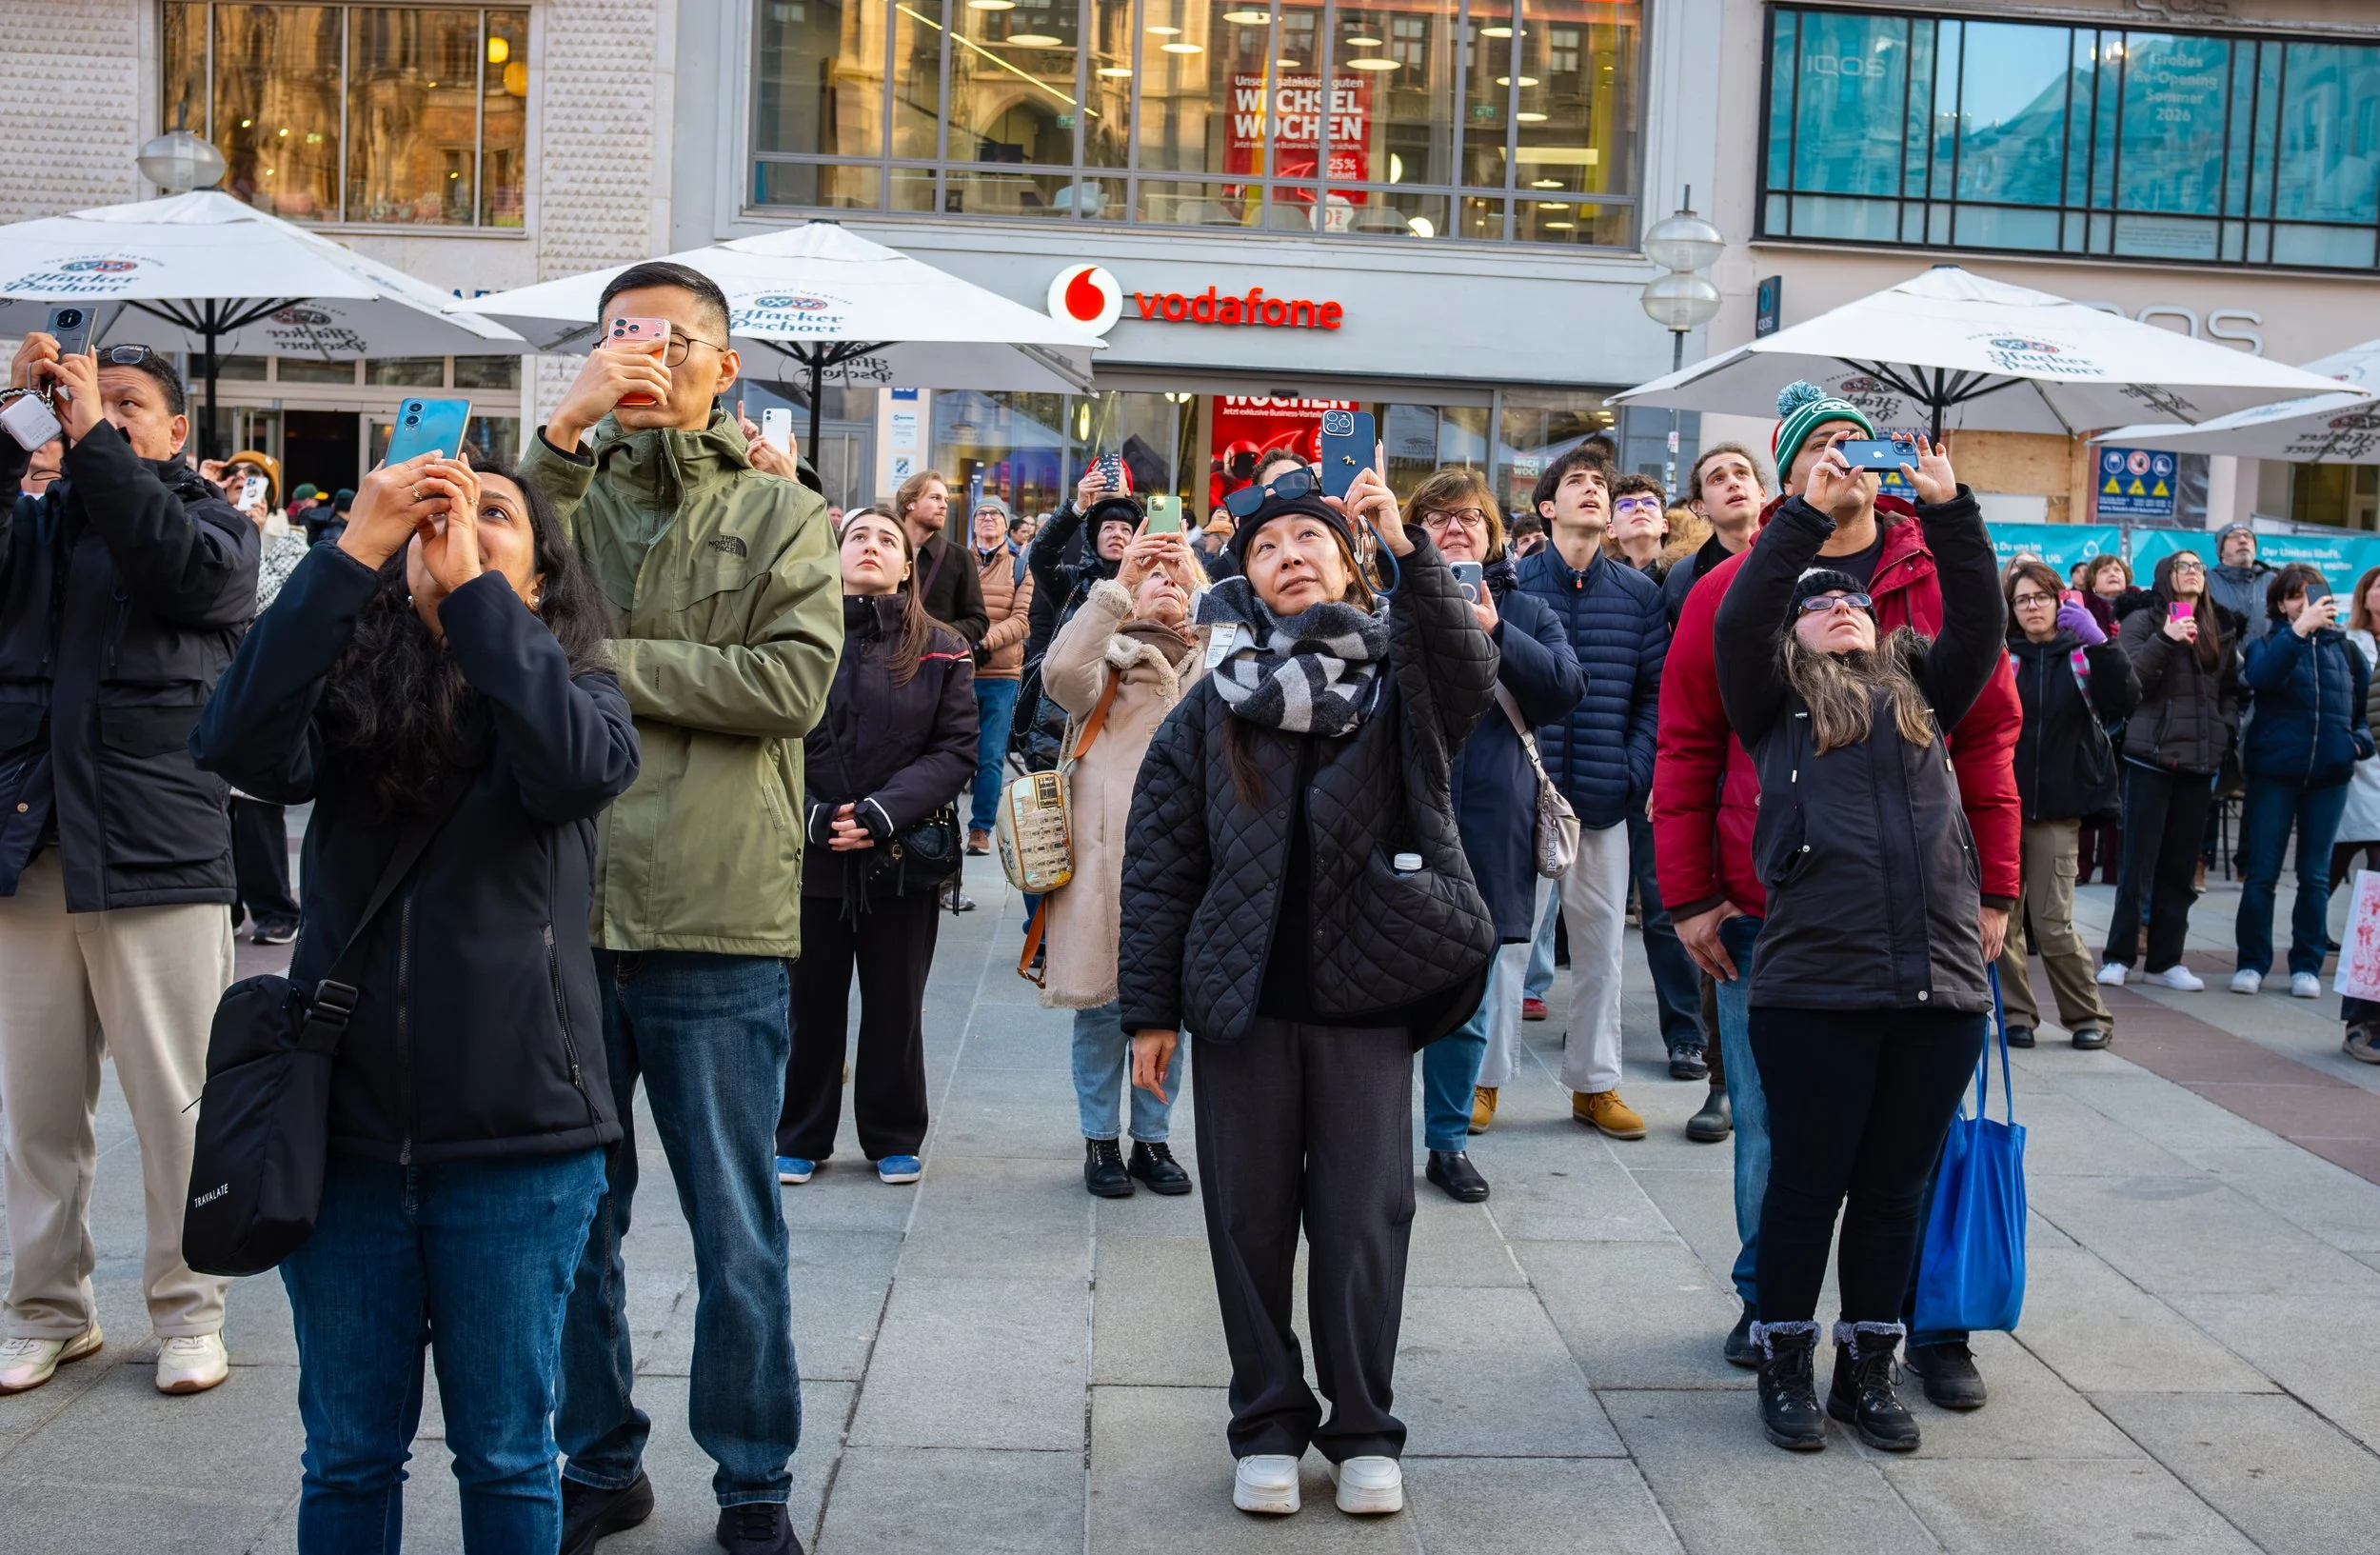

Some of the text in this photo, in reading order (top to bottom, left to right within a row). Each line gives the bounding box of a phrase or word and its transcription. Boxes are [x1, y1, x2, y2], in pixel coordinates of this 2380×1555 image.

[1806, 54, 1886, 77] IQOS
[2151, 52, 2204, 68] Großes
[1235, 76, 1364, 90] Unser galaktisc guten
[2133, 70, 2218, 90] Re-Opening
[2145, 89, 2205, 104] Sommer
[2155, 108, 2192, 122] 2026
[1328, 158, 1357, 170] 25%
[1326, 170, 1357, 180] Rabatt
[20, 273, 140, 284] Hacker
[1134, 286, 1344, 330] vodafone
[730, 309, 844, 323] Hacker
[730, 319, 843, 333] Pschorr
[1986, 349, 2093, 366] Hacker
[708, 540, 736, 548] NORTH
[720, 534, 736, 543] THE
[715, 546, 736, 554] FACE
[194, 1183, 228, 1208] TRAVALATE
